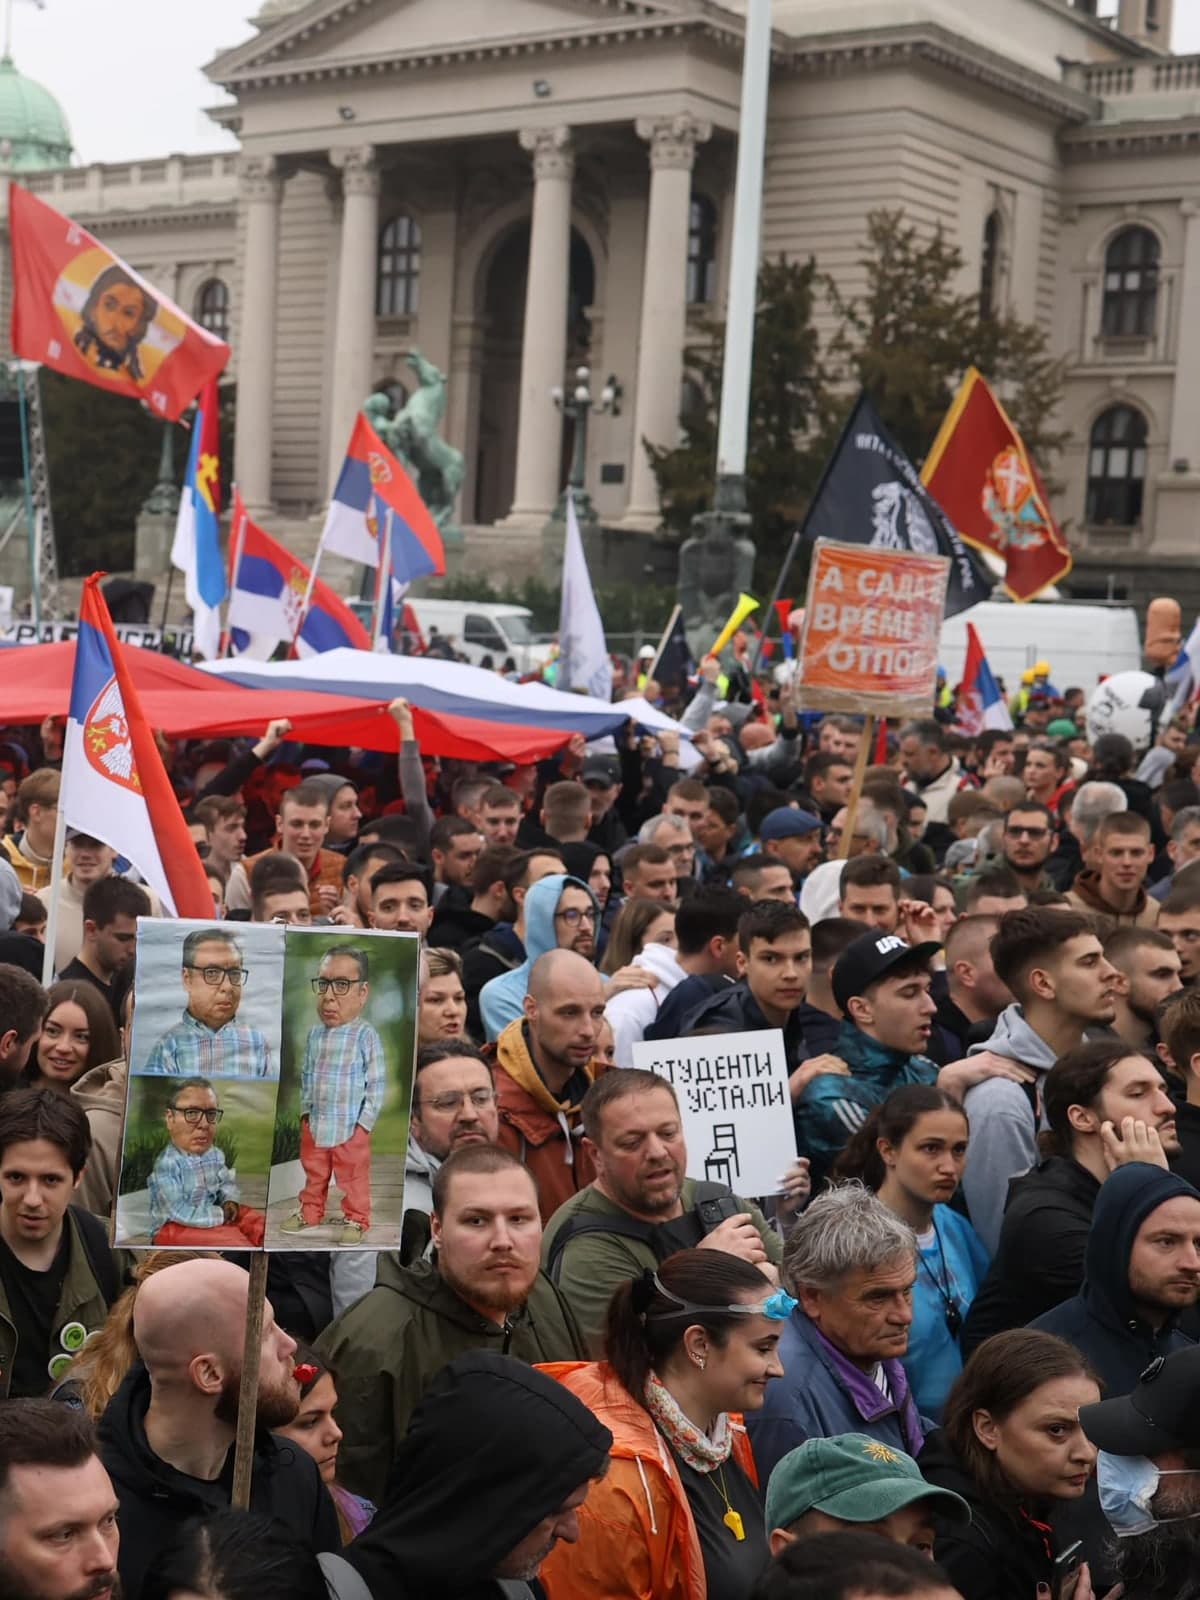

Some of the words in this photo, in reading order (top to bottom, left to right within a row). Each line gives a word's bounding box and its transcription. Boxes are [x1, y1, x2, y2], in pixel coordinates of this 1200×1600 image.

[820, 566, 844, 593] А
[813, 603, 913, 639] ВРЕМЕ
[687, 1080, 786, 1113] УСТАЛИ
